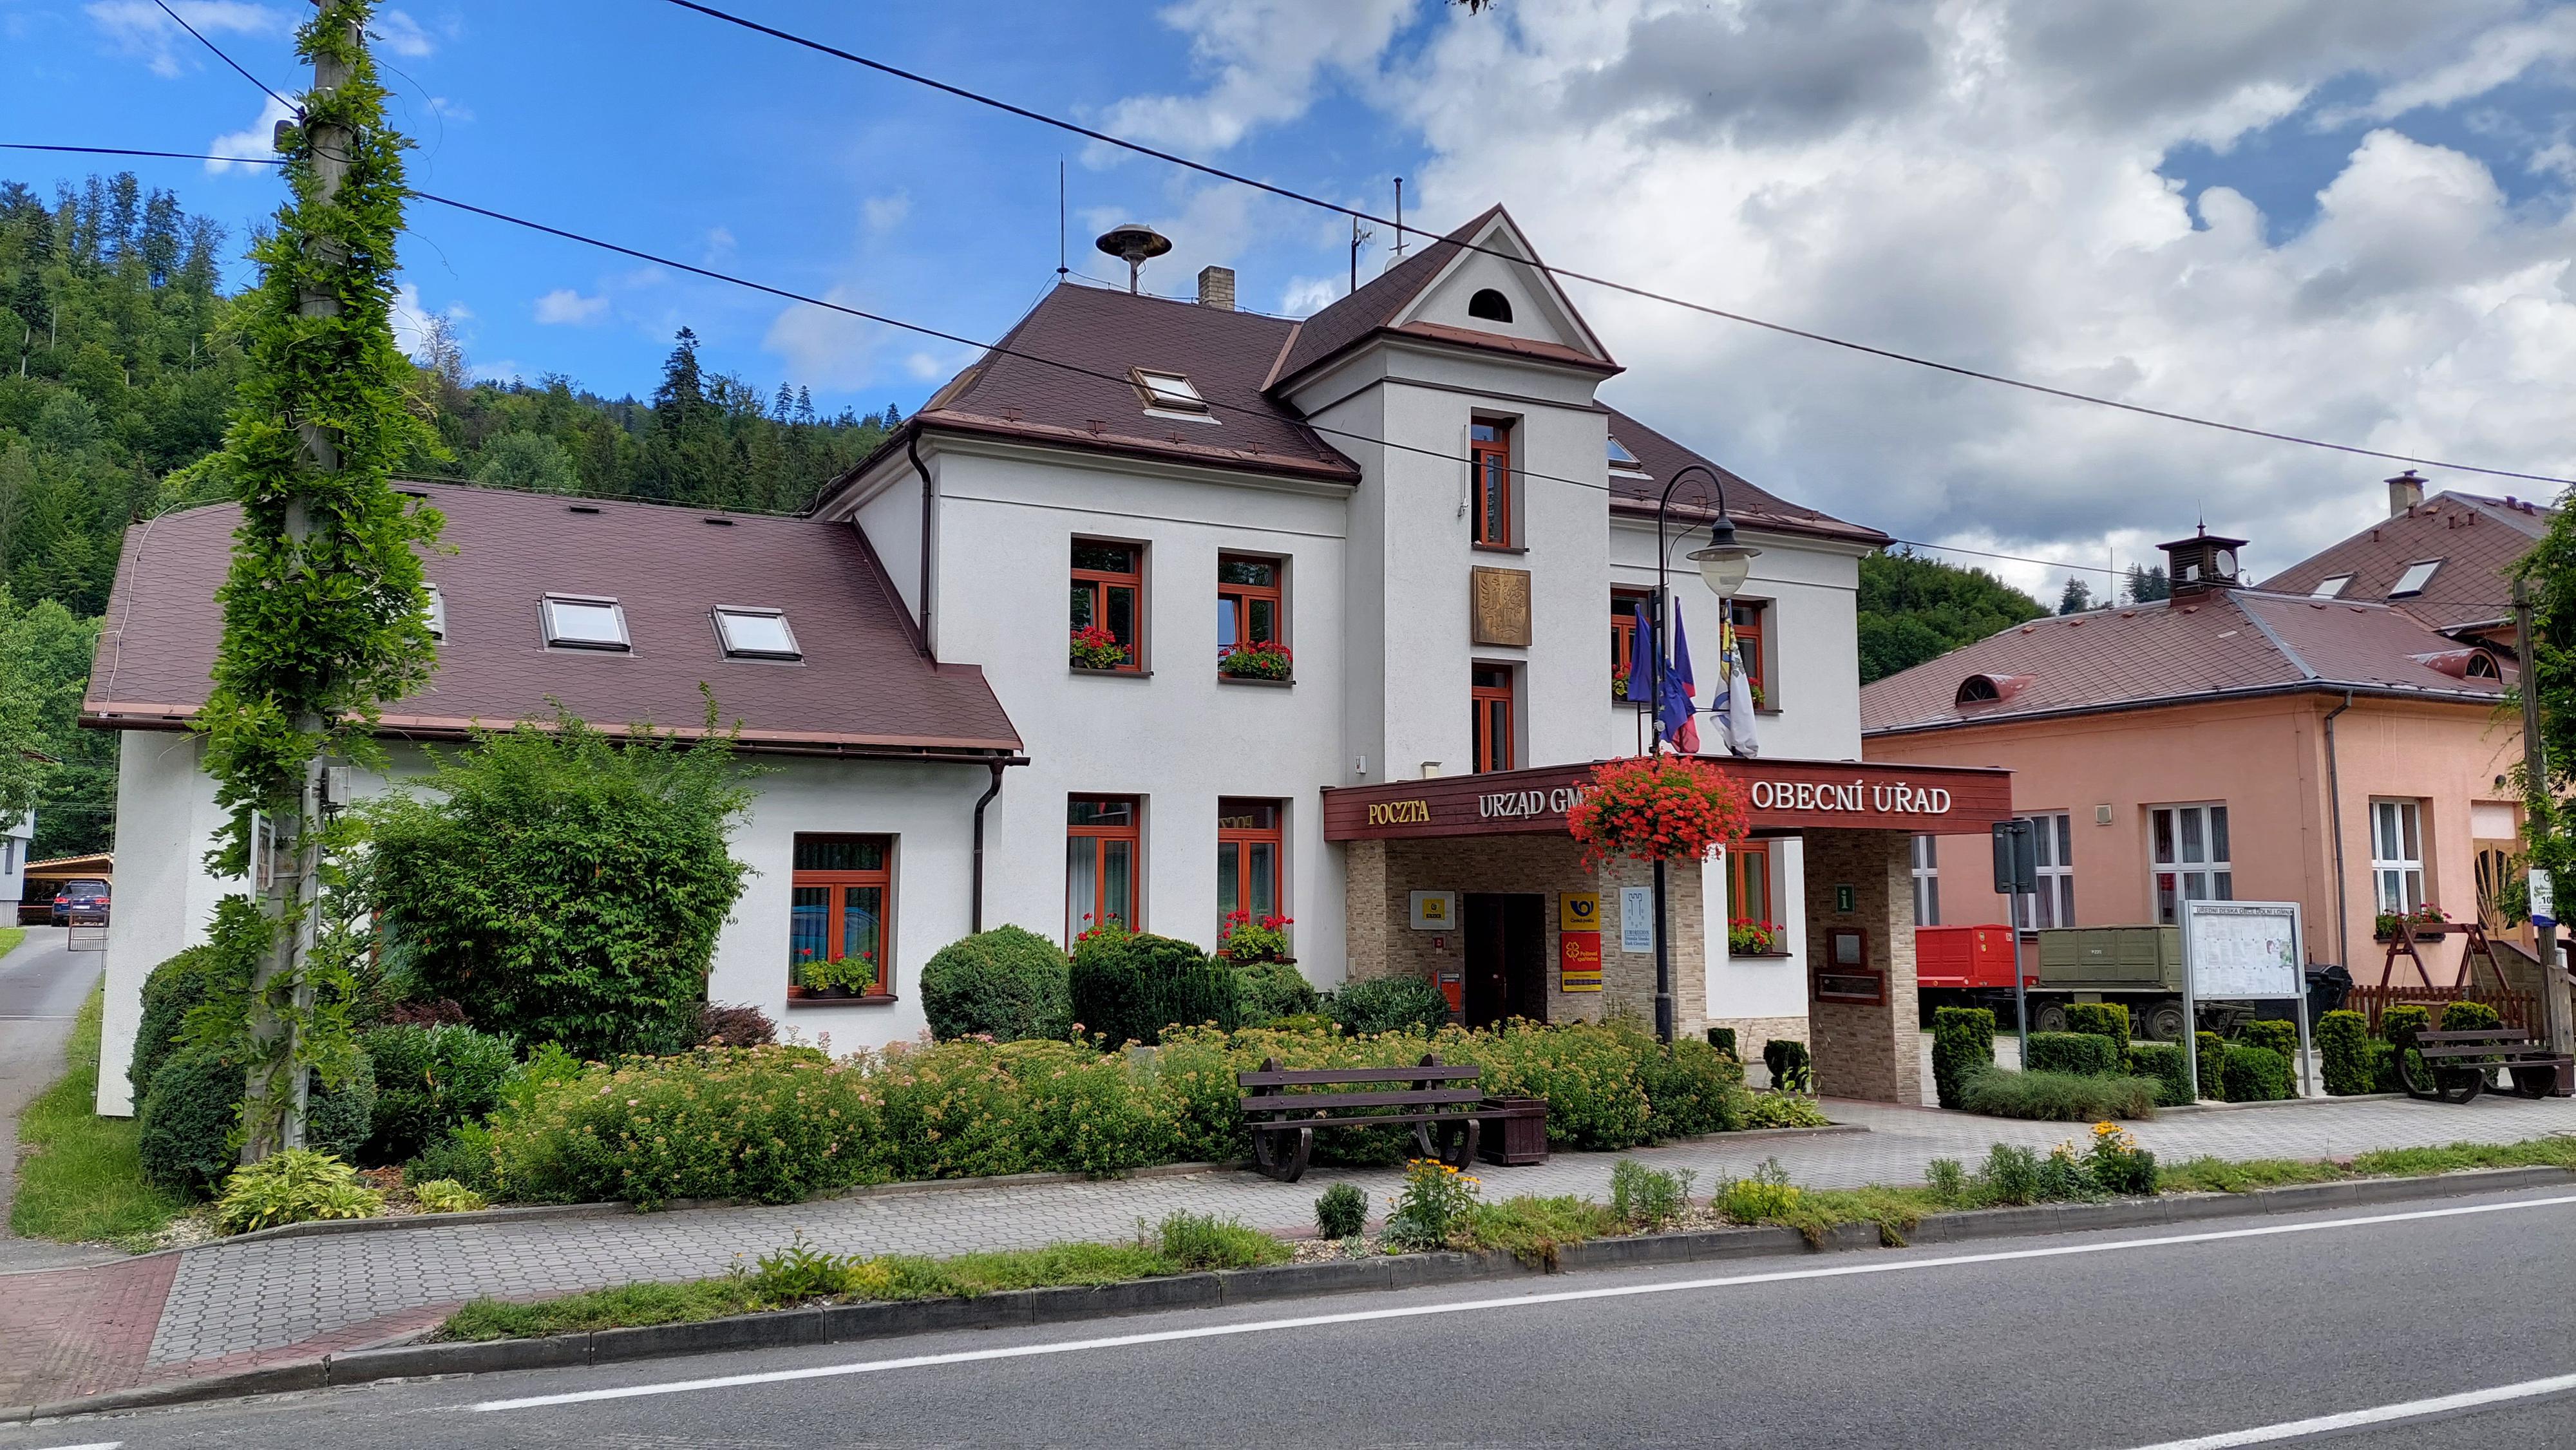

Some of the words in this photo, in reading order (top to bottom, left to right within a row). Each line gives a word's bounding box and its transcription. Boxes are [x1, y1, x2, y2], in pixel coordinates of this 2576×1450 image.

[1479, 791, 1546, 820] URZĄD
[1751, 778, 1866, 811] OBECNÍ
[1871, 780, 1951, 814] ÚŘAD
[1368, 800, 1430, 825] POCZTA
